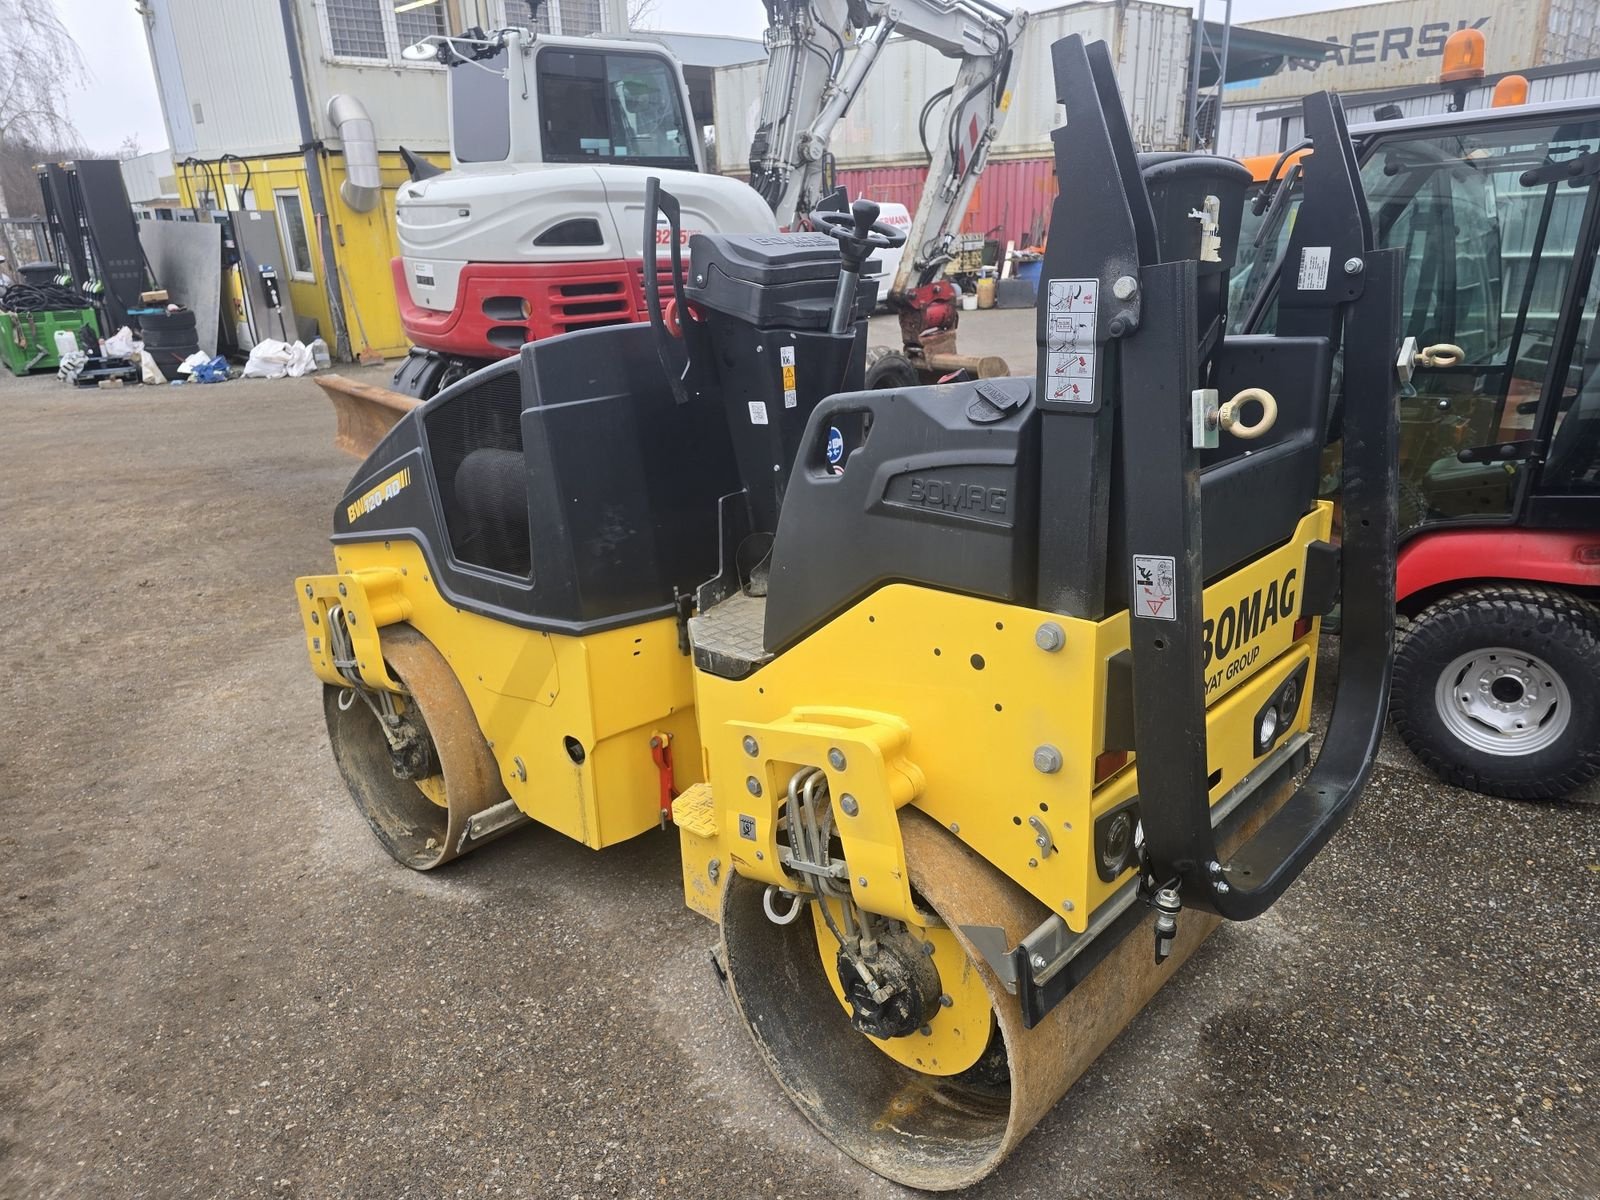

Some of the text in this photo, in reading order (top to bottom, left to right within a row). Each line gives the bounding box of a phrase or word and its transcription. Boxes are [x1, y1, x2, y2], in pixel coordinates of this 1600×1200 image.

[911, 478, 1007, 514] BOMAG
[1202, 568, 1297, 671] BOMAG
[1225, 645, 1260, 681] GROUP
